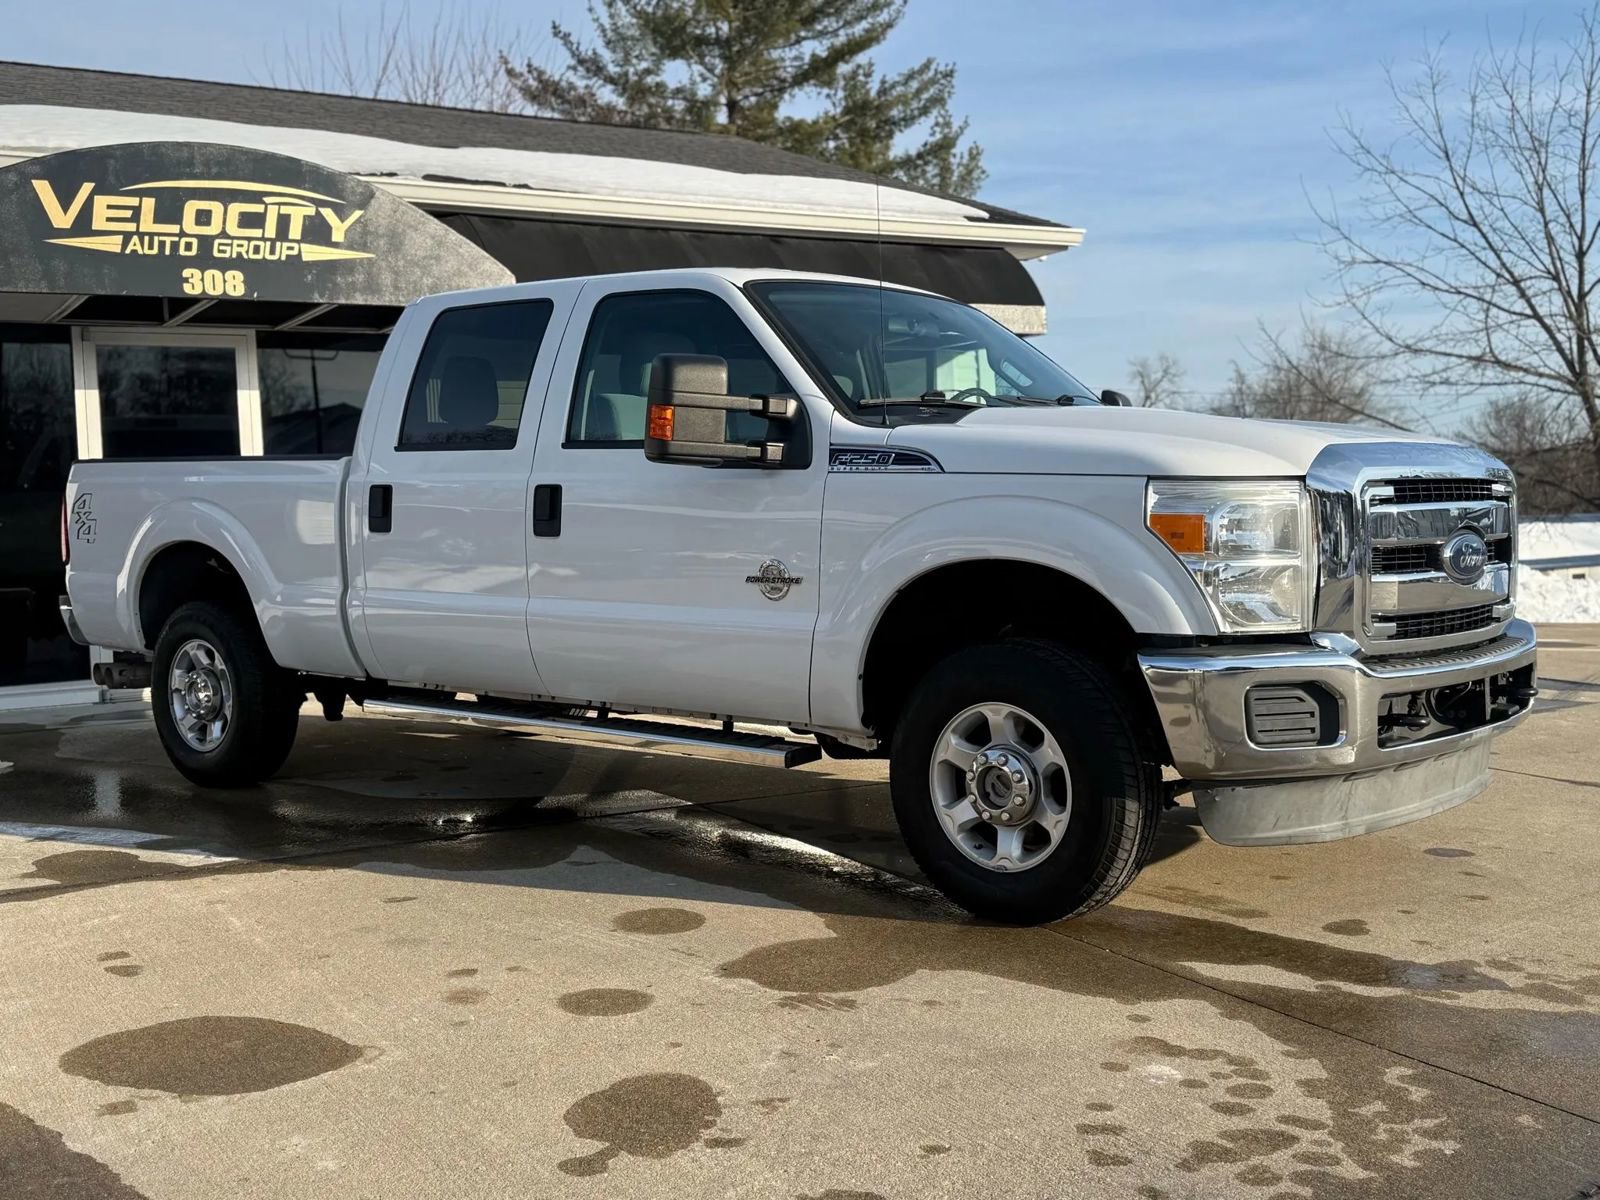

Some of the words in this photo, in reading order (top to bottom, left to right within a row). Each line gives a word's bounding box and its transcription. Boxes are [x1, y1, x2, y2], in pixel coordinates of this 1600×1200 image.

[31, 179, 365, 243] VELOCITY
[124, 234, 199, 257] AUTO
[212, 238, 301, 262] GROUP
[182, 268, 246, 297] 308
[1459, 541, 1486, 569] Ford
